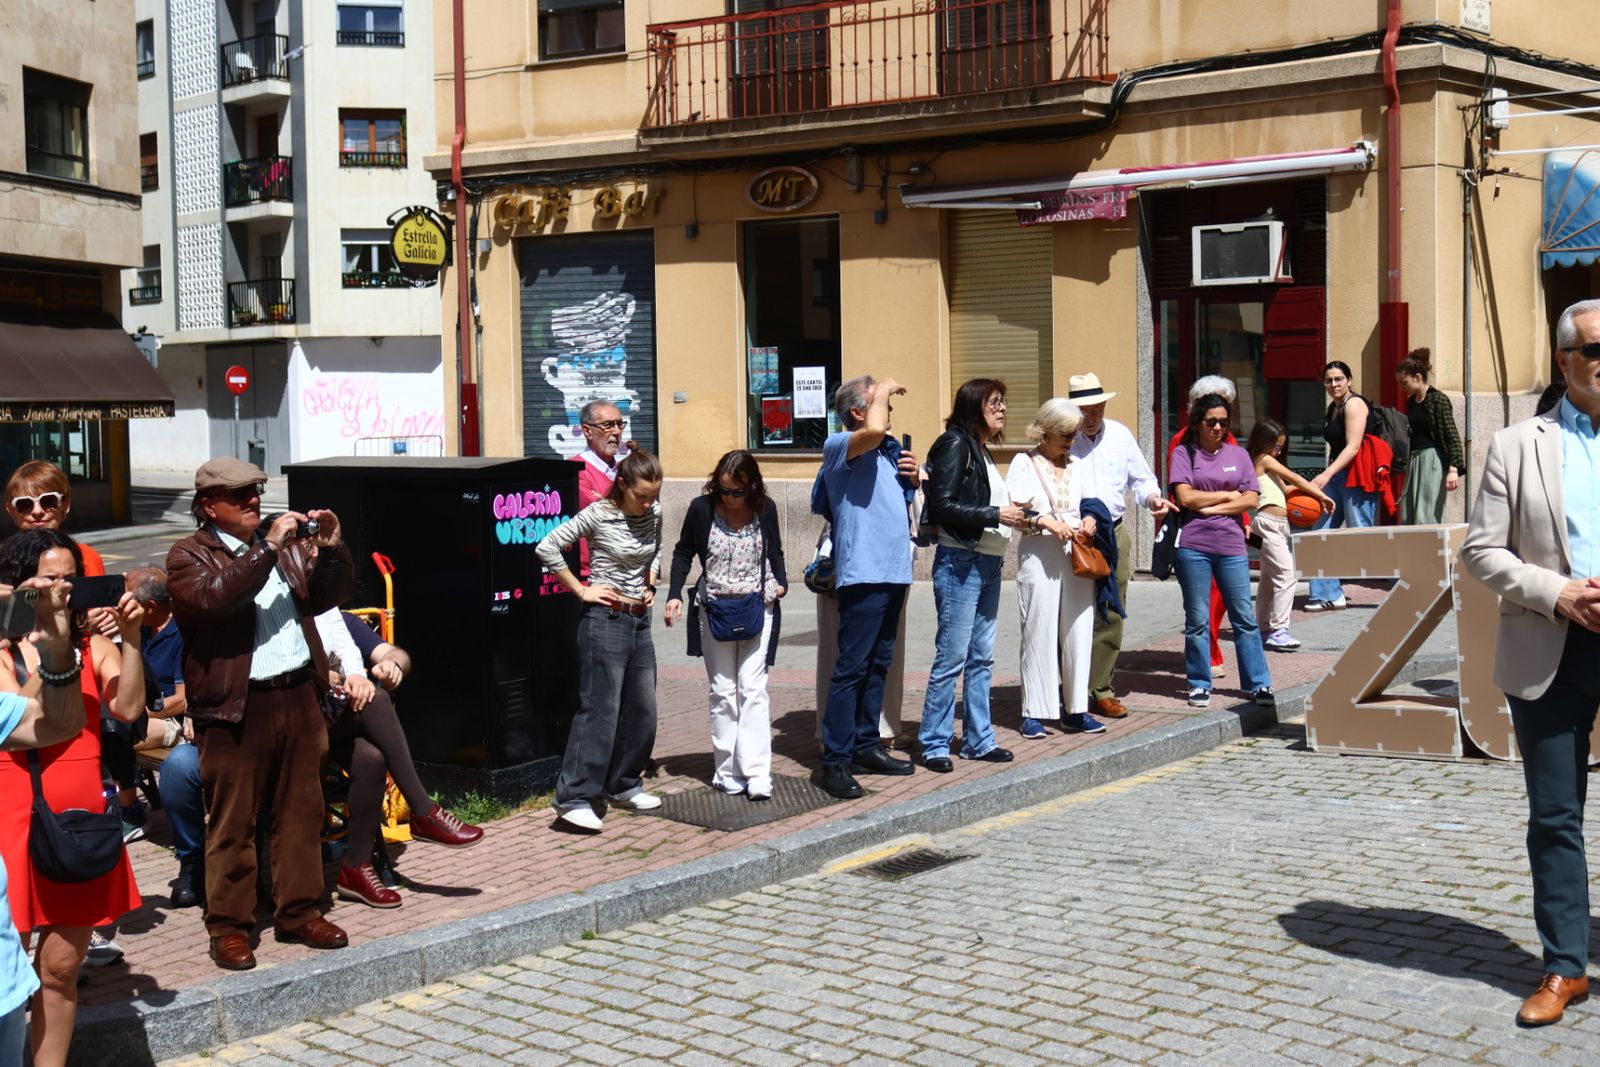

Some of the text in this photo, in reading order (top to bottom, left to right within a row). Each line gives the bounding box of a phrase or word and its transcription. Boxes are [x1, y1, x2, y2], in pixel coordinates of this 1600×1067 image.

[757, 175, 807, 204] MT
[594, 185, 666, 218] Bar
[402, 228, 438, 245] Estrella
[404, 243, 437, 260] Galicia
